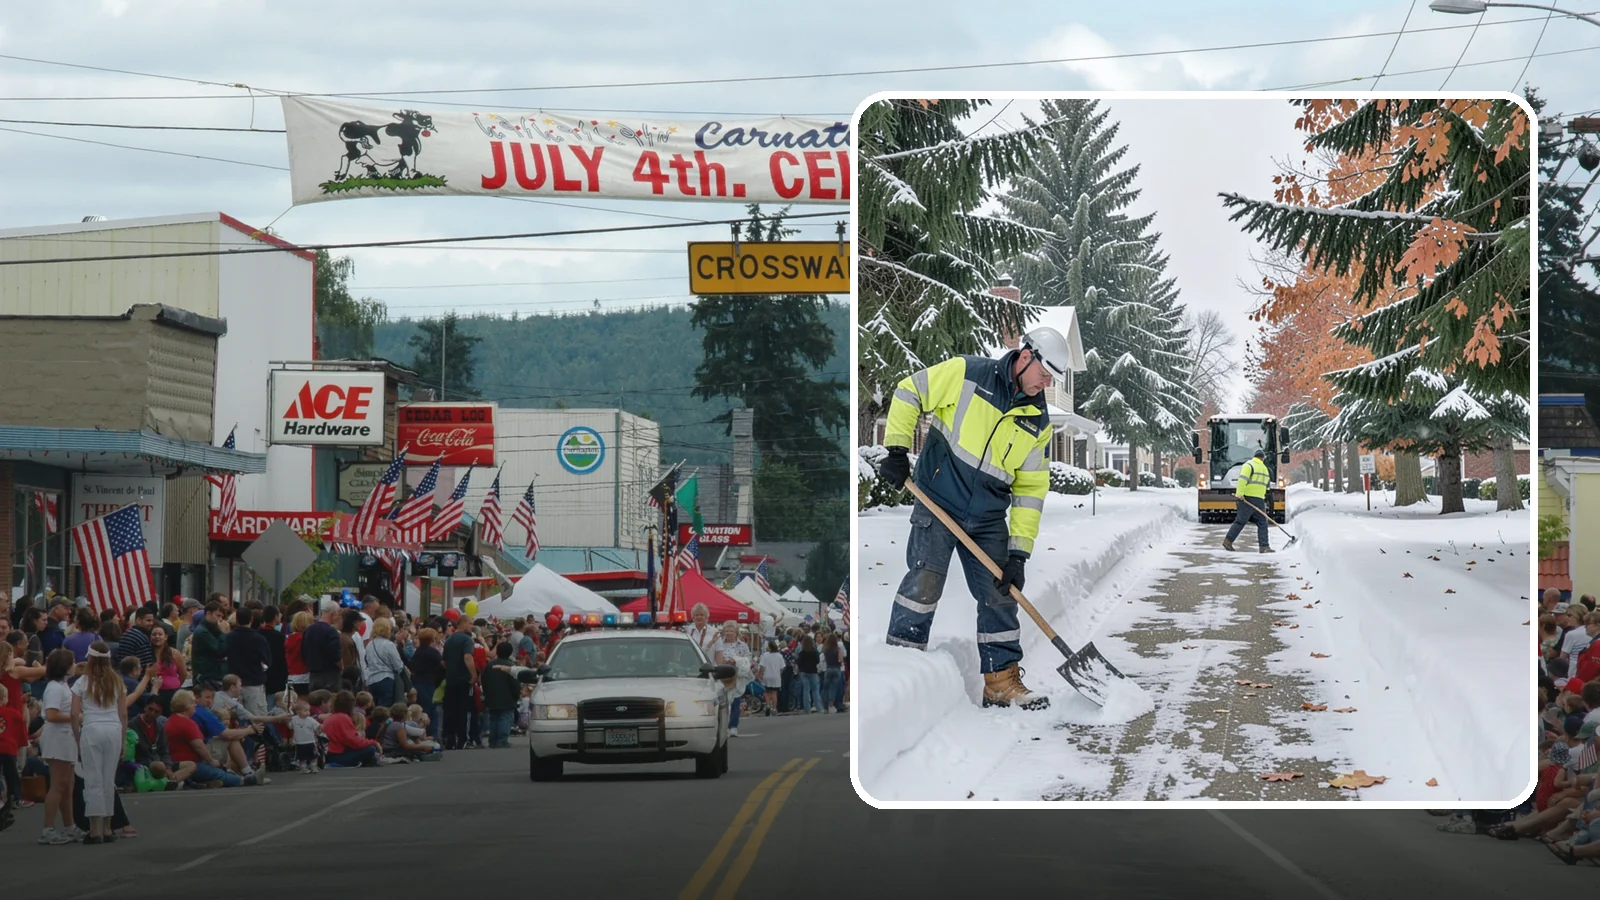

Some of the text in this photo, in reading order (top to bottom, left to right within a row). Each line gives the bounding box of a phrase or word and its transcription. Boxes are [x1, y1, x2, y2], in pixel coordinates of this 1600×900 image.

[478, 141, 605, 193] JULY
[632, 150, 746, 197] 4th.
[696, 254, 850, 280] CROSSWA
[283, 380, 374, 420] ACE
[406, 409, 485, 421] CEDAR LOG
[283, 421, 371, 437] Hardware
[416, 428, 477, 447] Coca-Cola
[354, 467, 385, 480] Simpl
[95, 485, 124, 494] Vincent
[126, 486, 135, 495] de
[138, 486, 155, 495] Paul
[81, 503, 154, 522] THT
[212, 515, 331, 535] HARDARE
[688, 526, 742, 535] CRNATION
[699, 535, 730, 543] GLASS
